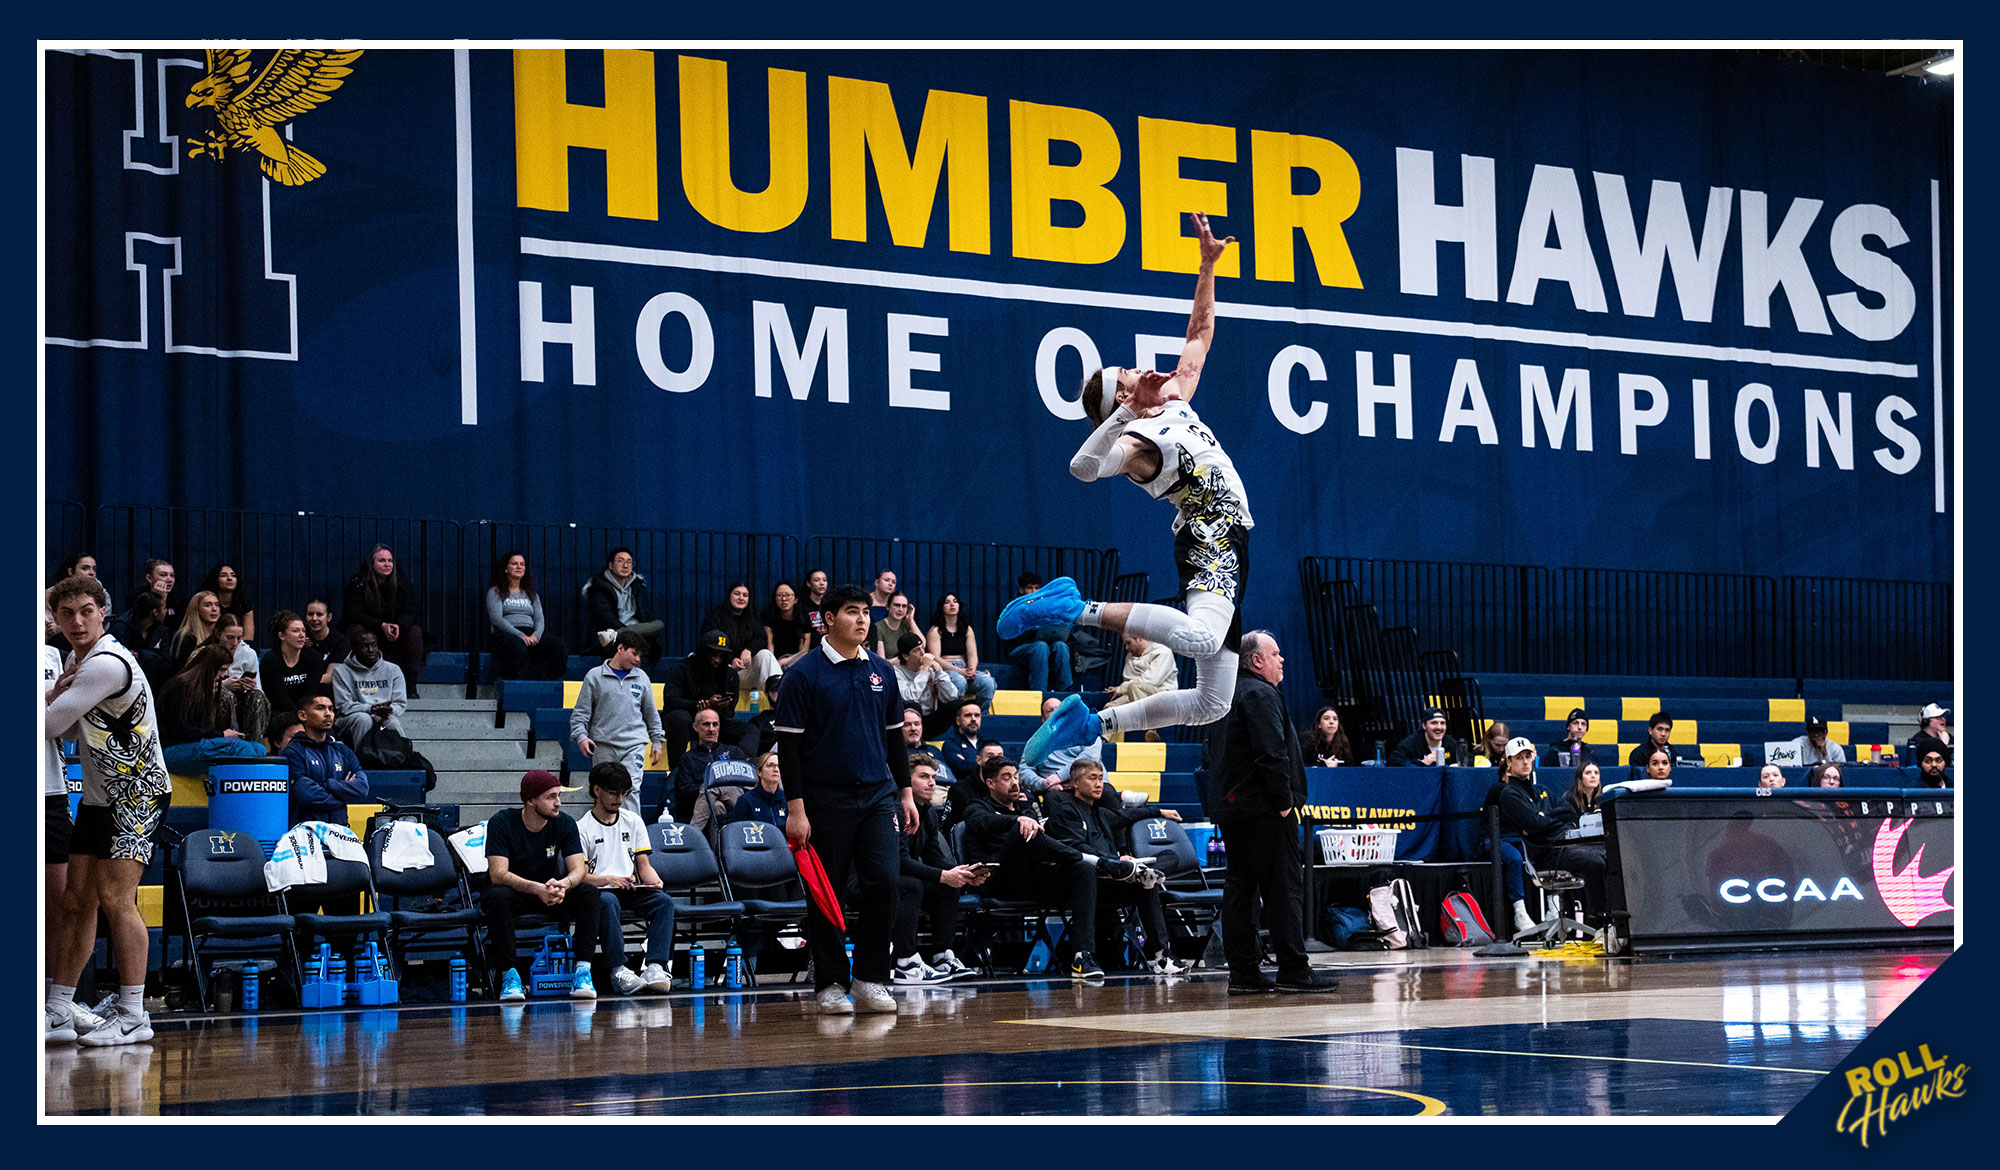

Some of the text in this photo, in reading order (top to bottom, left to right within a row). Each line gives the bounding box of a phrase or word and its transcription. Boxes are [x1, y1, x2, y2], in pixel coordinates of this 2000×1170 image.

[514, 45, 1916, 341] HUMBER HAWKS
[519, 281, 951, 411] HOME
[1268, 344, 1921, 475] CHAMPIONS
[718, 636, 726, 646] H
[1769, 747, 1796, 761] Lewis
[712, 761, 755, 779] HUMBER
[224, 781, 287, 792] POWERADE
[1860, 801, 1943, 815] B P P B
[1719, 877, 1864, 904] CCAA
